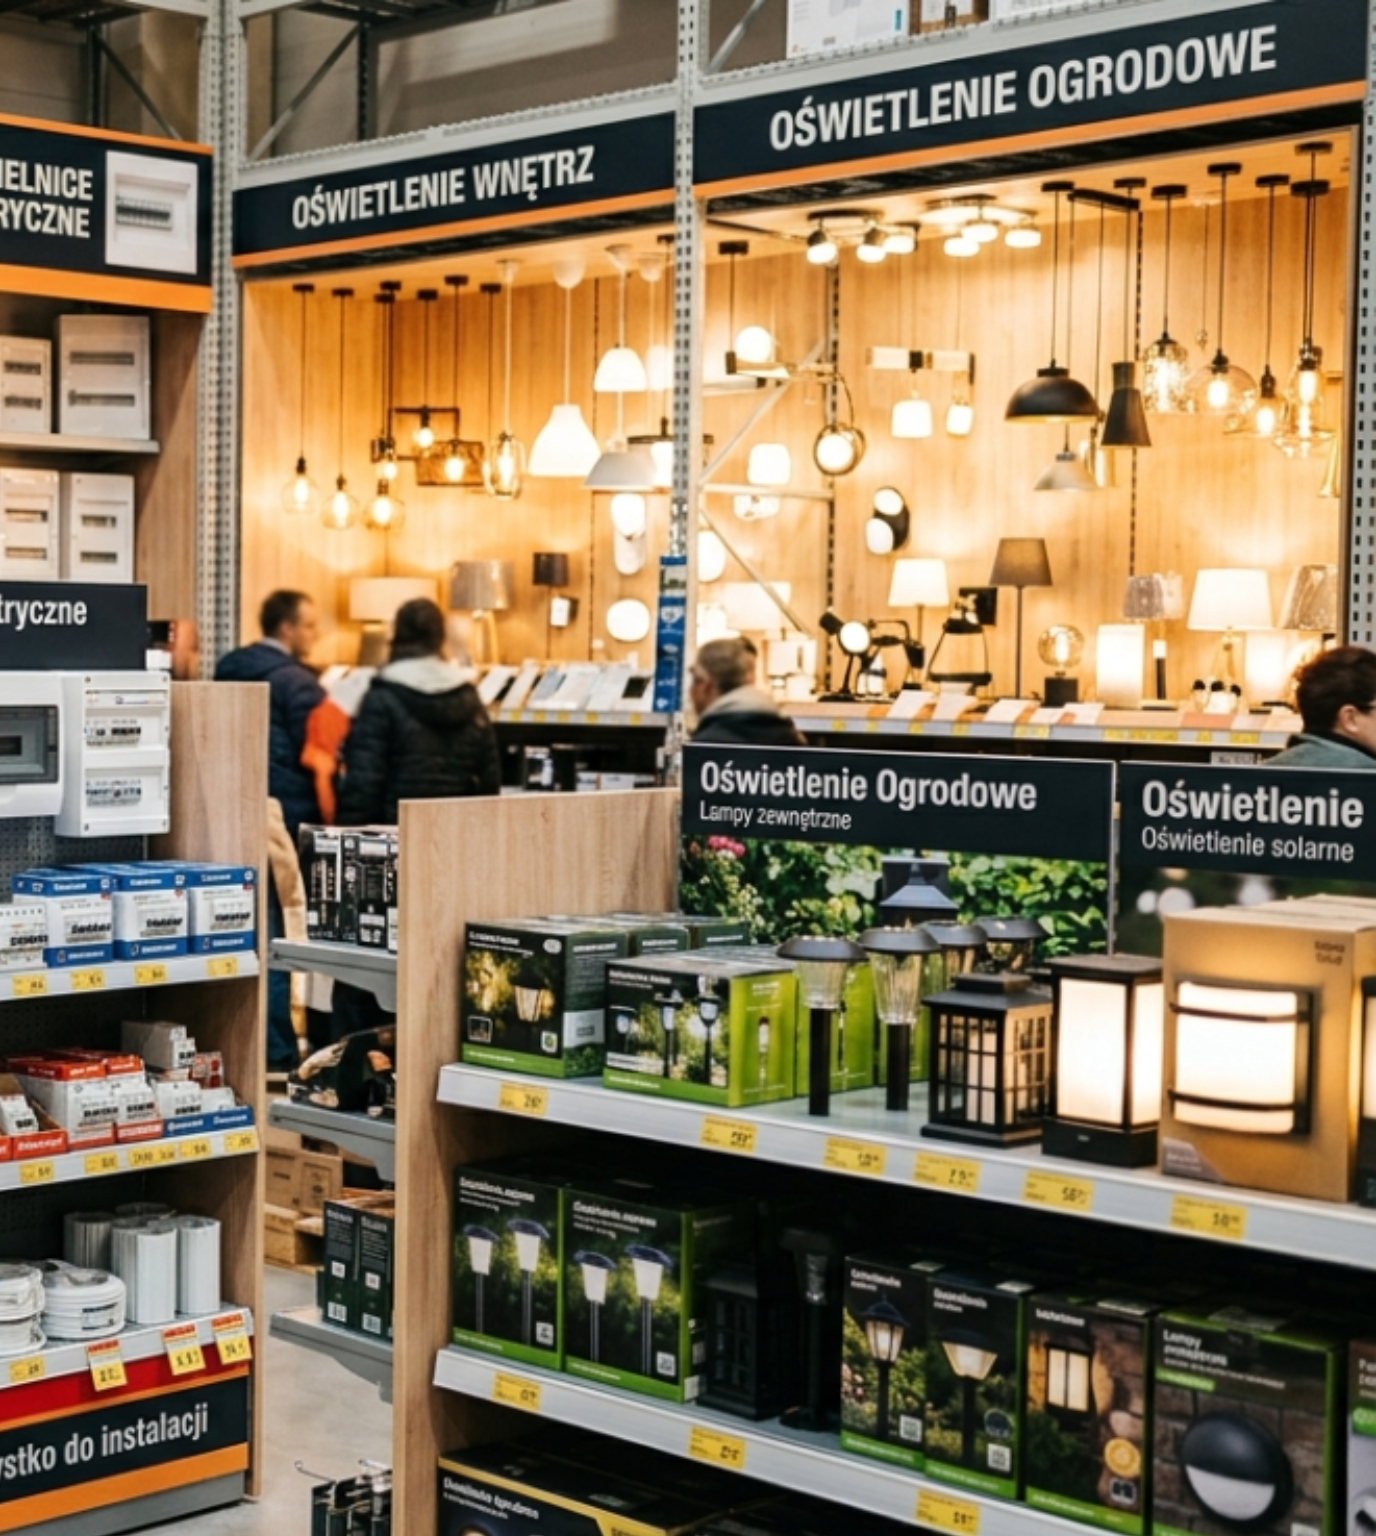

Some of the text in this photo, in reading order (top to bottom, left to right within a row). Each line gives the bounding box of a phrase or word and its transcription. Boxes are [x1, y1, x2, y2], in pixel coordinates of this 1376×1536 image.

[770, 25, 1277, 151] OŚWIETLENIE OGRODOWE
[292, 145, 595, 230] OŚWIETLENIE WNĘTRZ
[700, 760, 1037, 811] Oświetlenie Ogrodowe
[1142, 779, 1365, 829] Oświetlenie
[700, 800, 753, 828] Lampy
[1271, 836, 1355, 863] solarne
[64, 1432, 94, 1466] do
[101, 1402, 209, 1457] instalacji
